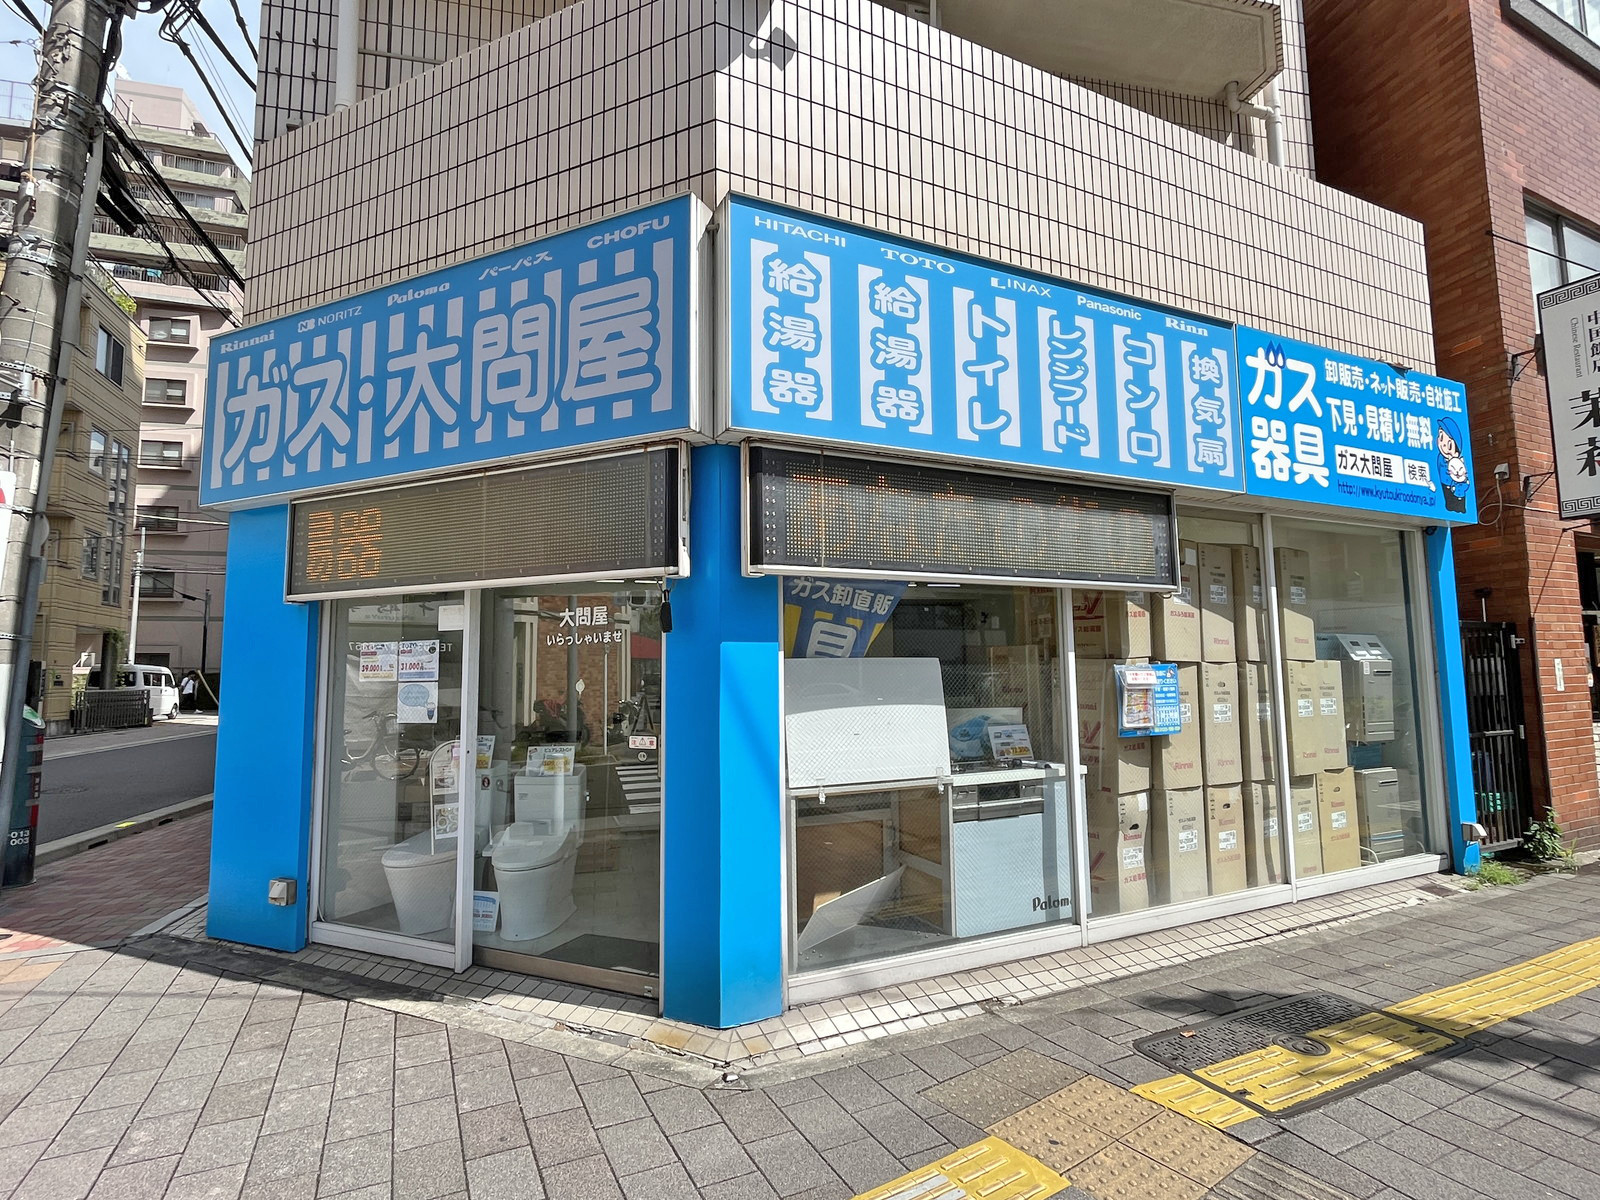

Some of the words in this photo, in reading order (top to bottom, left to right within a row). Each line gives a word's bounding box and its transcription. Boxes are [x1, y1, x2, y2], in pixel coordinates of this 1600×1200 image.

[587, 215, 671, 249] CHOFU
[754, 215, 846, 248] HITACHI
[478, 250, 553, 281] パーパス
[880, 247, 956, 275] TOTO
[387, 281, 450, 307] Paloma
[1077, 294, 1142, 321] Panasonic
[317, 305, 363, 327] NORITZ
[768, 257, 818, 407] 給湯器
[1165, 316, 1209, 337] Rinn
[1570, 316, 1580, 343] Chinese
[220, 329, 276, 354] Rinnai
[873, 280, 921, 421] 給湯器
[966, 300, 1010, 432] トイレ
[1573, 343, 1583, 379] Restaurant
[1049, 318, 1088, 446] レンジフード
[1245, 340, 1323, 418] ガス
[1324, 358, 1462, 413] 卸販売・ネット販売・自社施工
[1121, 336, 1158, 458] コンロ
[1191, 352, 1225, 467] 換気扇
[1325, 396, 1433, 451] 下見・見積り無料
[1251, 416, 1330, 488] 器具
[1337, 450, 1394, 479] ガス大問屋
[1407, 462, 1430, 482] 検索
[791, 576, 895, 616] ガス卸直販
[559, 605, 609, 628] 大問屋
[546, 630, 623, 646] いらっしゃいませ
[10, 836, 30, 846] 003
[1032, 895, 1072, 912] Palom
